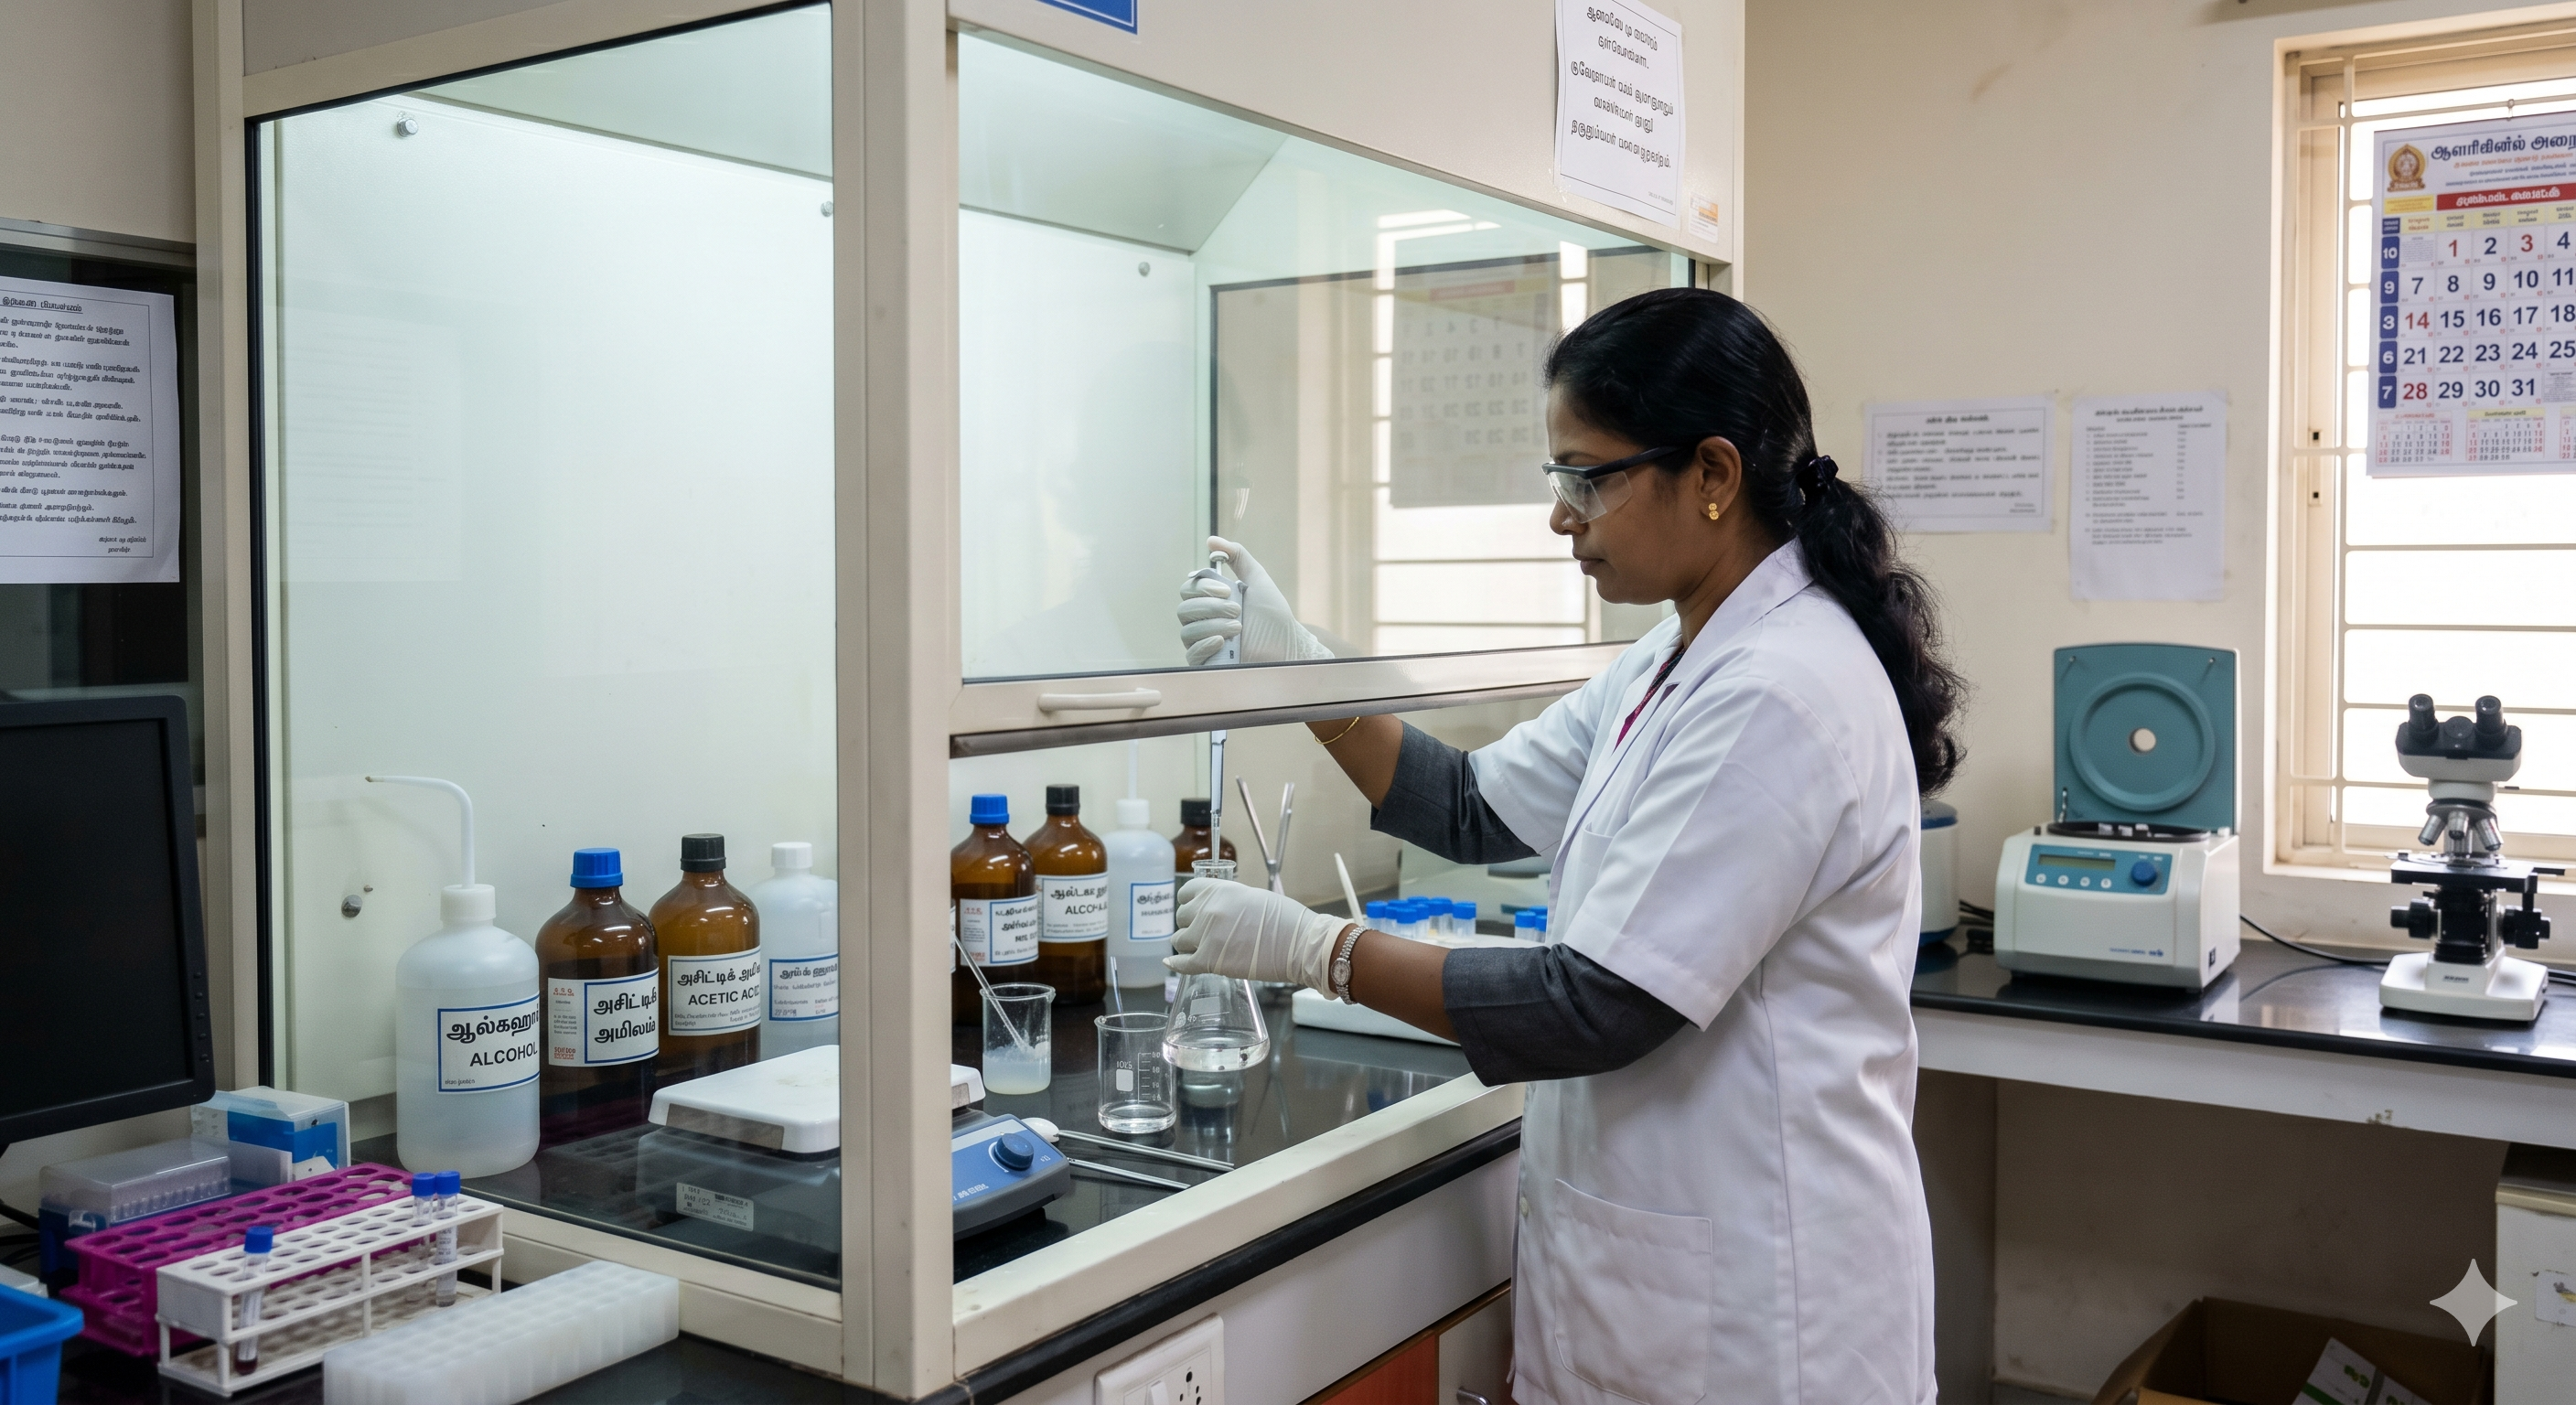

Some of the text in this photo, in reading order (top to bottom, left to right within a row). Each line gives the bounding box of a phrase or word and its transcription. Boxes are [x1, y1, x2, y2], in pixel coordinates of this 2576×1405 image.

[2383, 231, 2571, 259] 10 1 2 3 4
[2384, 267, 2574, 295] 9 7 8 9 10 11
[2383, 304, 2576, 330] 3 14 15 16 17 18
[2382, 340, 2576, 365] 6 21 22 23 24 25
[2381, 378, 2535, 400] 7 28 29 30 31
[688, 991, 738, 1006] ACETIC
[469, 1041, 538, 1067] ALCOHOL
